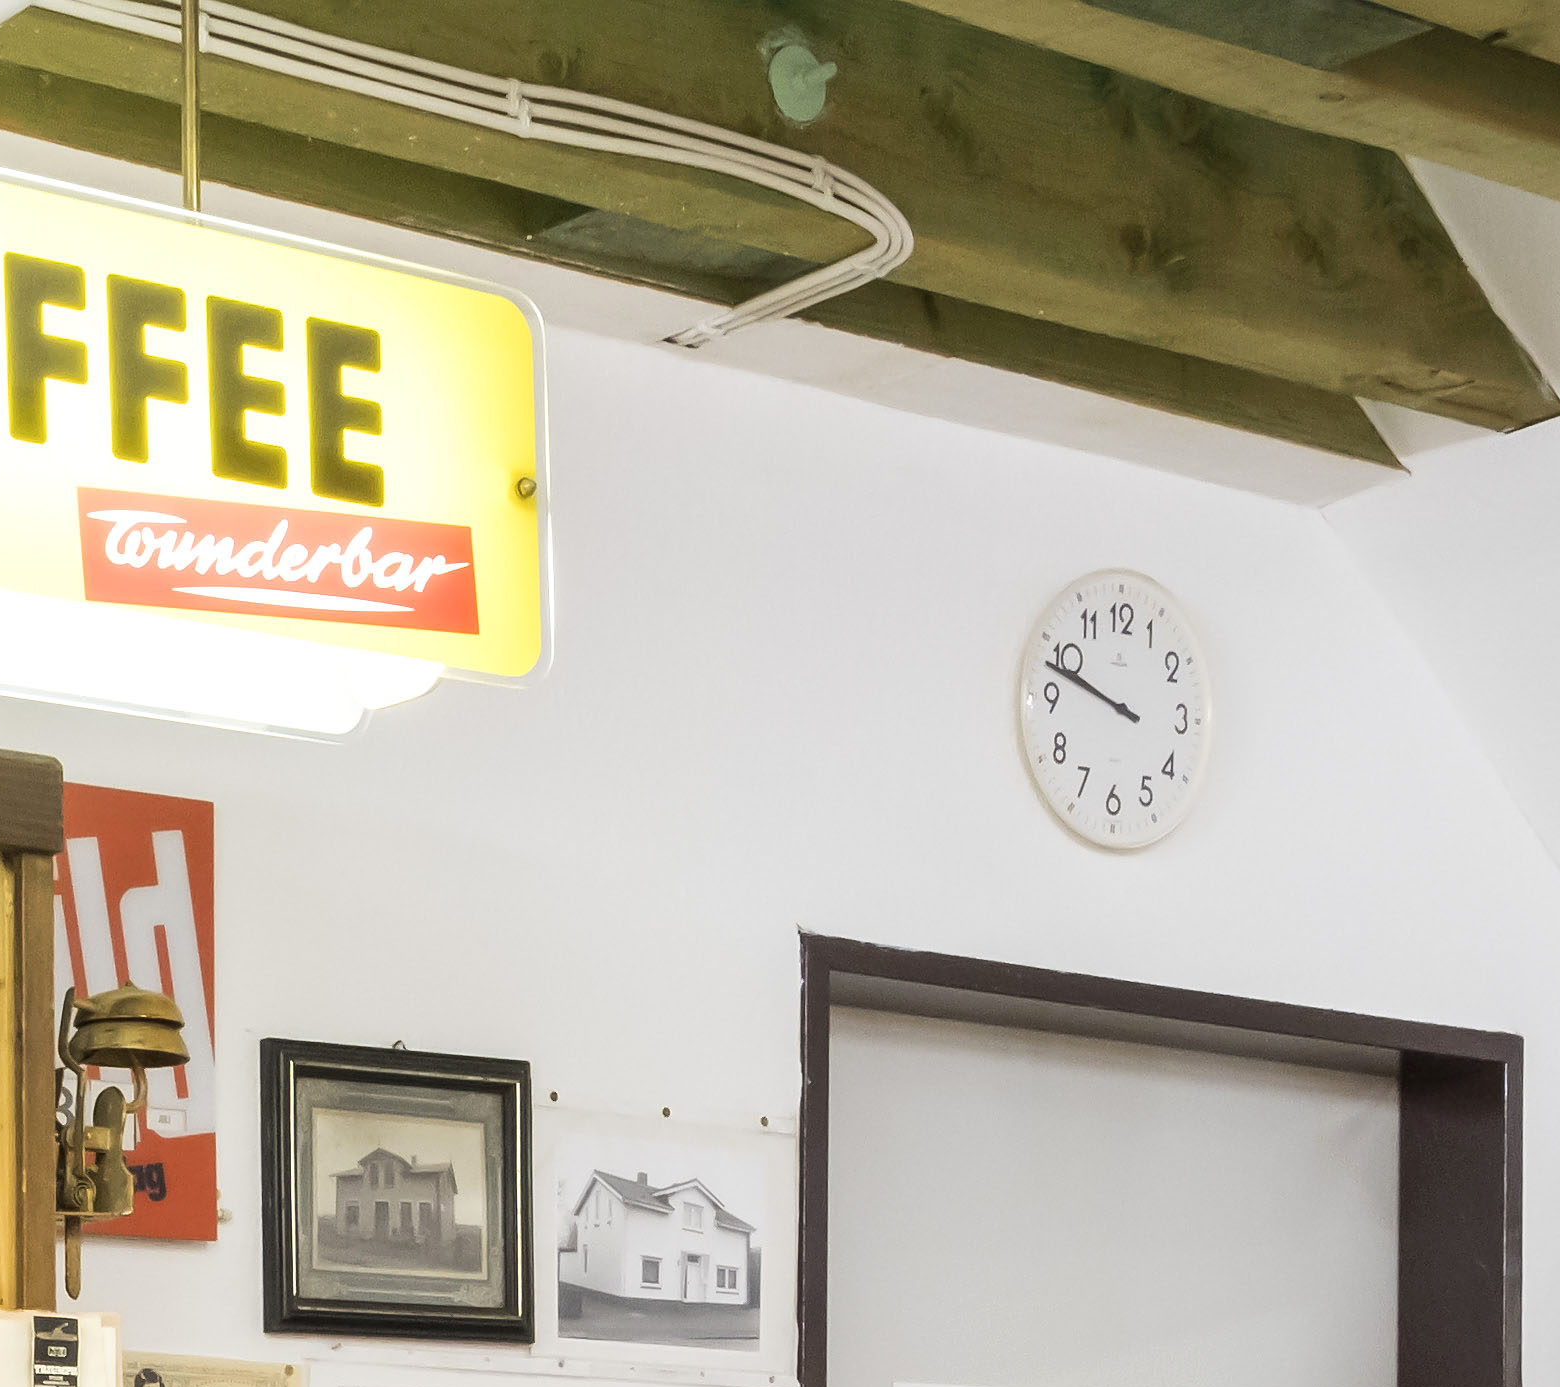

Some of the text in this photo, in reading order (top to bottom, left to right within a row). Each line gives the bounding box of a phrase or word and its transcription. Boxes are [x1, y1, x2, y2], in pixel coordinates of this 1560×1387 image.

[1080, 608, 1097, 639] 11
[1110, 602, 1134, 635] 12
[1147, 619, 1153, 648] 1
[1053, 641, 1083, 675] 10
[1165, 651, 1179, 683] 2
[1044, 682, 1059, 714] 9
[1174, 703, 1187, 735] 3
[1053, 733, 1066, 764] 8
[1161, 750, 1175, 780] 4
[1078, 766, 1090, 798] 7
[1139, 776, 1153, 806] 5
[1106, 784, 1121, 815] 6
